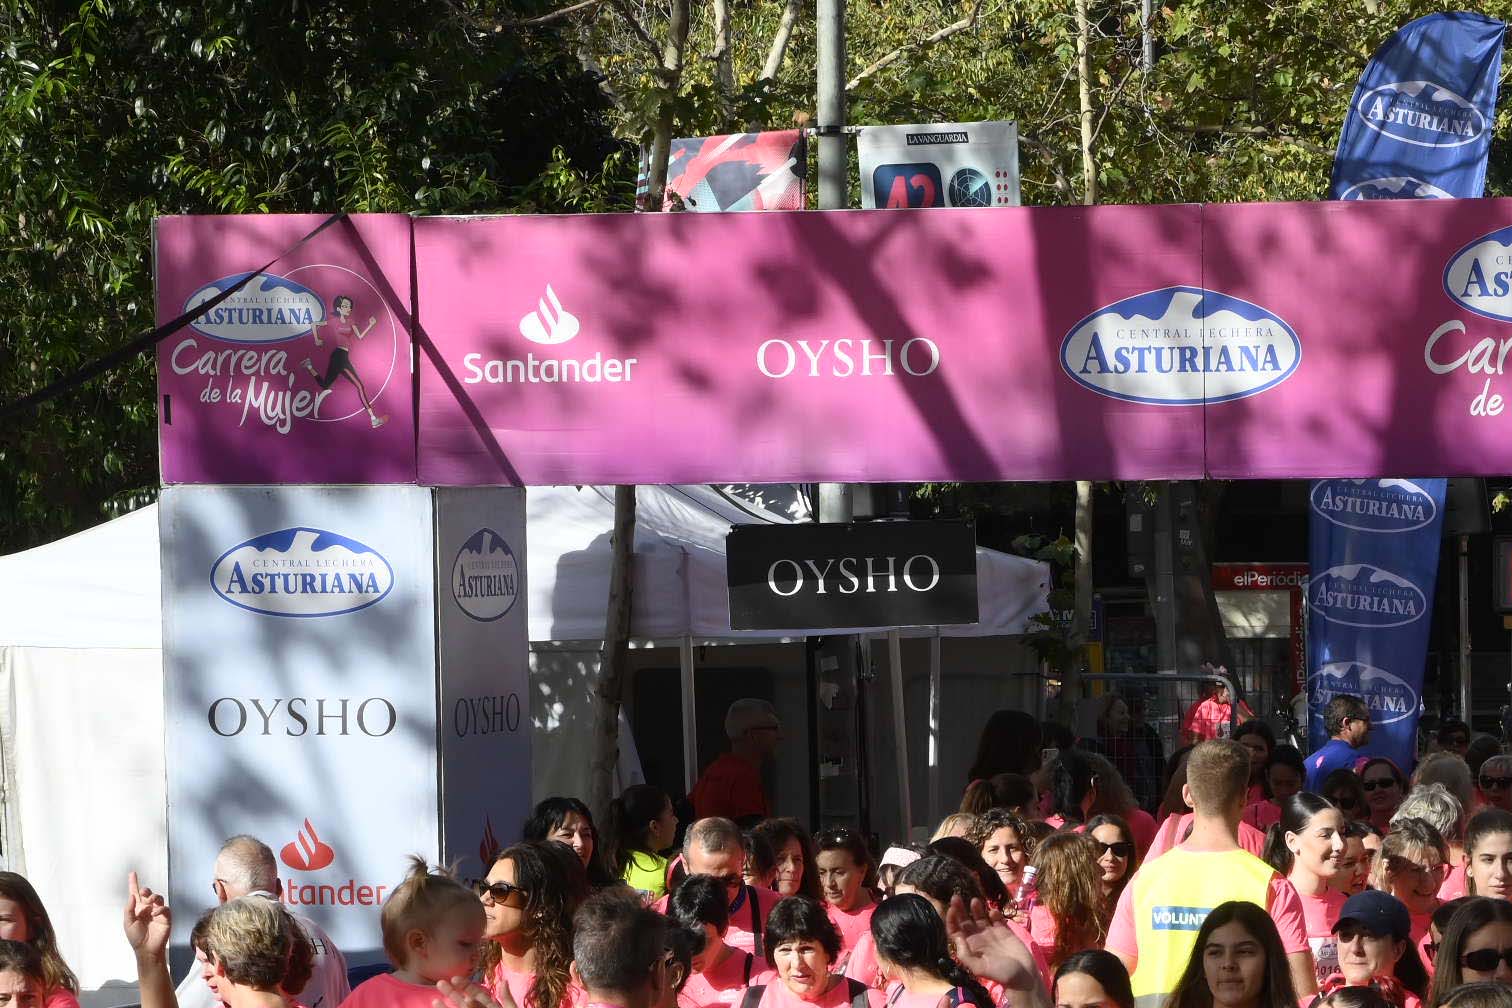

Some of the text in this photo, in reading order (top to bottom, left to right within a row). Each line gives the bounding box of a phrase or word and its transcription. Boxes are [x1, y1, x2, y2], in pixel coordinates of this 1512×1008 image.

[1367, 95, 1475, 137] ASTURIANA
[1116, 328, 1191, 339] CENTRAL
[171, 338, 288, 376] Carrera
[463, 351, 637, 384] Santander
[756, 337, 941, 378] OYSHO
[1078, 332, 1283, 376] ASTURIANA
[200, 372, 333, 435] de la Mujer
[1469, 377, 1504, 417] de
[1320, 486, 1426, 522] ASTURIANA
[225, 561, 381, 595] ASTURIANA
[252, 558, 310, 568] CENTRAL
[457, 562, 515, 599] ASTURIANA
[769, 555, 940, 597] OYSHO
[1233, 570, 1303, 587] elPeriódi
[1313, 581, 1418, 617] ASTURIANA
[207, 696, 397, 737] OYSHO
[454, 692, 521, 738] OYSHO
[283, 879, 387, 906] tander
[1153, 911, 1209, 925] VOLUNT
